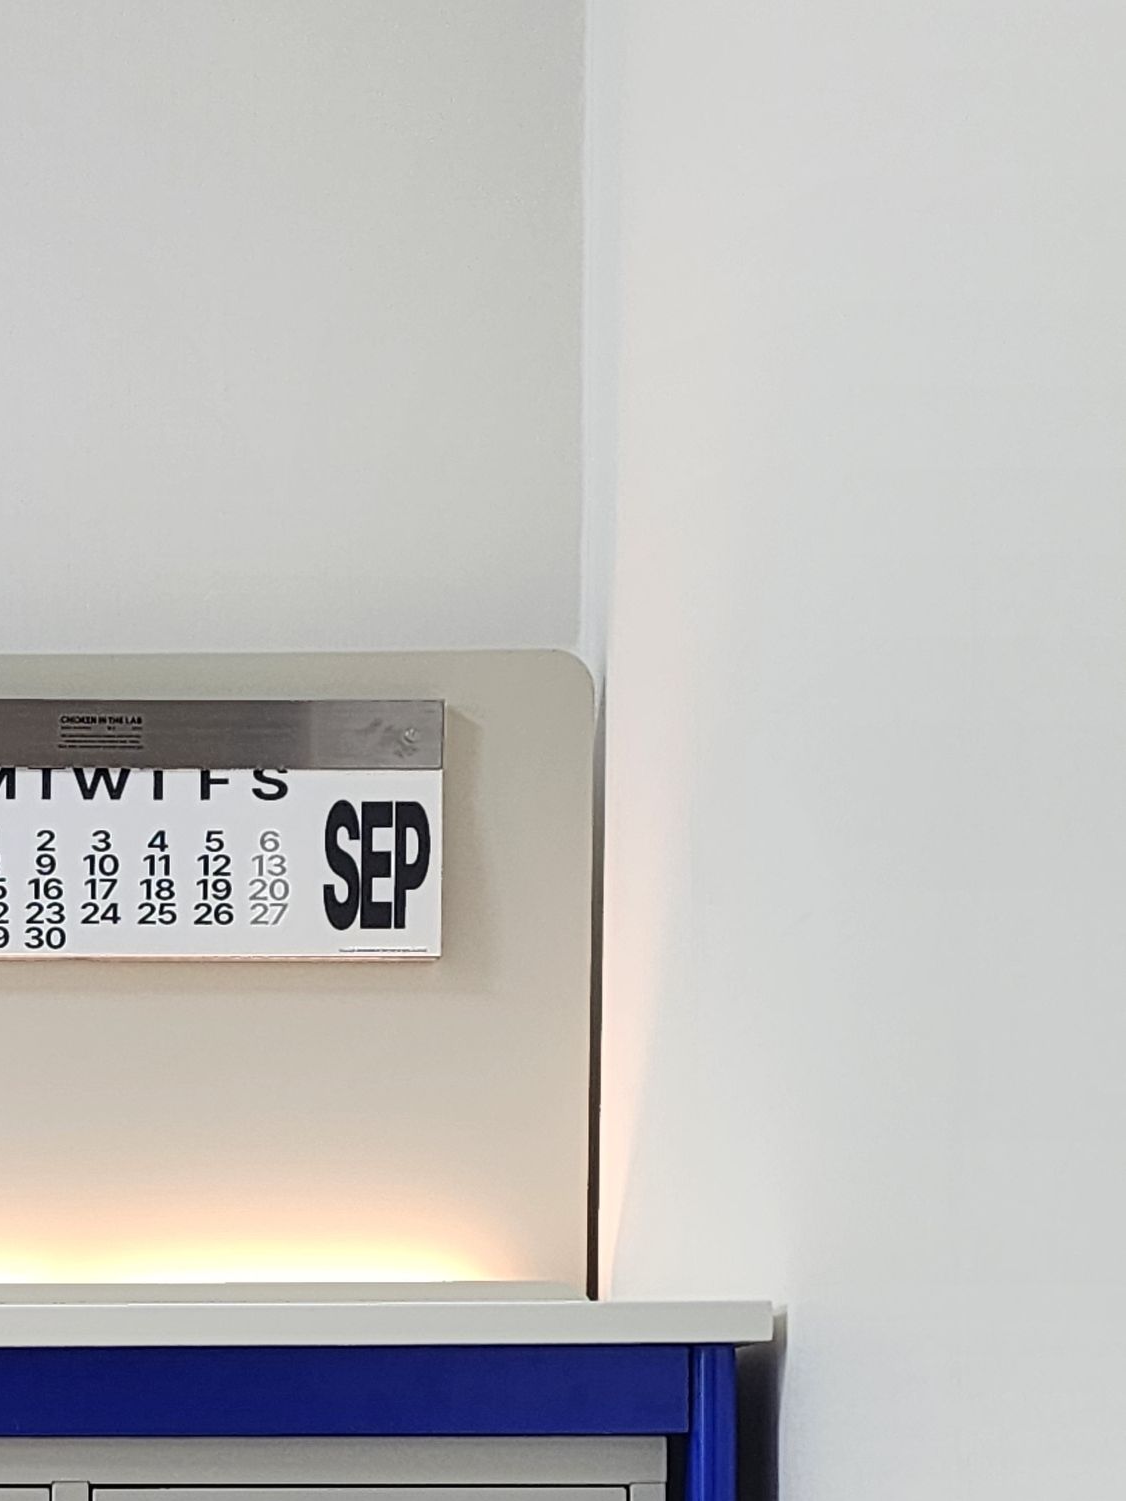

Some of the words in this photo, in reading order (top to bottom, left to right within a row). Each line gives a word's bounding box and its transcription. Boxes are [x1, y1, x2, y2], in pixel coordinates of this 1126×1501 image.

[98, 715, 107, 725] IN
[108, 715, 123, 725] THE
[125, 715, 142, 725] LAB
[73, 767, 131, 800] W
[251, 769, 288, 801] S
[36, 830, 56, 852] 2
[91, 830, 112, 852] 3
[148, 830, 169, 852] 4
[204, 830, 225, 852] 5
[260, 831, 280, 853] 6
[36, 853, 56, 876] 9
[83, 854, 119, 876] 10
[142, 854, 170, 876] 11
[197, 854, 231, 876] 12
[251, 854, 286, 876] 13
[323, 799, 431, 930] SEP
[28, 878, 63, 900] 16
[84, 878, 118, 900] 17
[140, 878, 175, 901] 18
[196, 878, 232, 901] 19
[249, 879, 289, 901] 20
[25, 902, 65, 924] 23
[80, 902, 121, 924] 24
[137, 902, 177, 925] 25
[194, 903, 234, 925] 26
[250, 903, 288, 925] 27
[24, 926, 66, 950] 30
